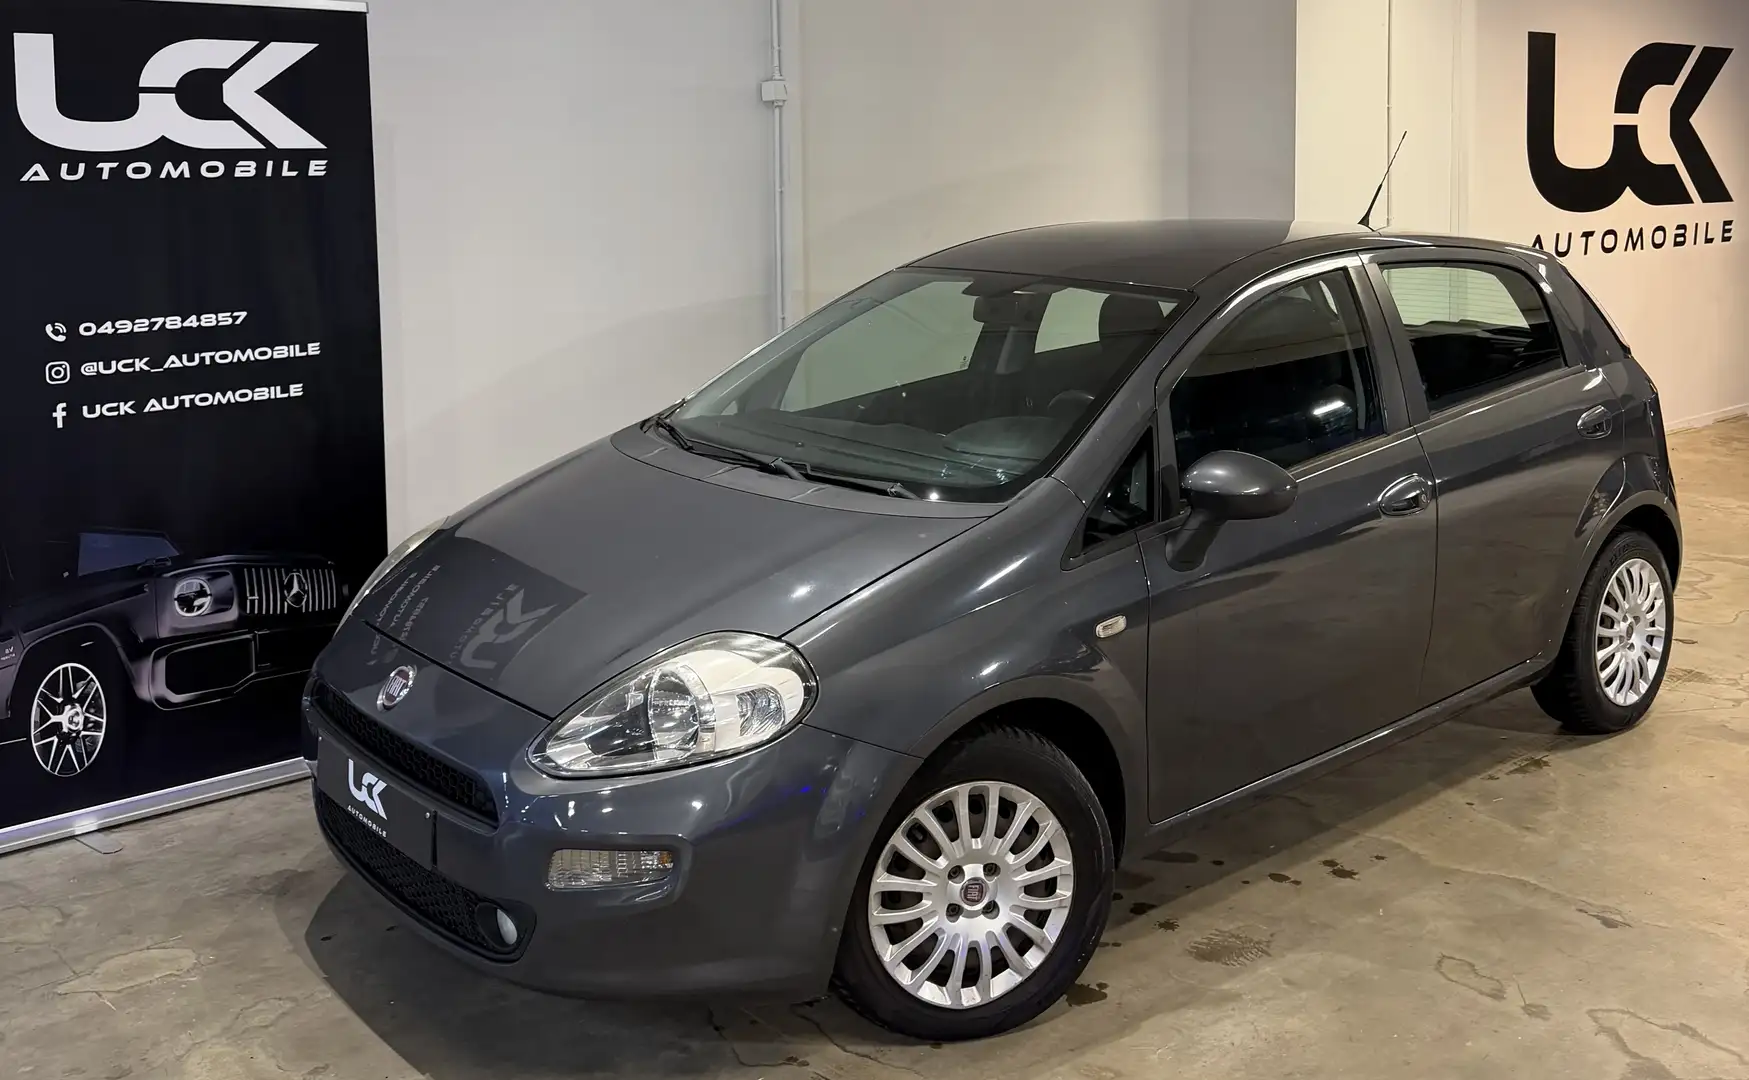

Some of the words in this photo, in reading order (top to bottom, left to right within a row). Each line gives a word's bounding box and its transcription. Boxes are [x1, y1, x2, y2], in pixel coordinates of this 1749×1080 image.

[13, 32, 328, 152] UCK
[1526, 31, 1735, 213] UCK
[20, 160, 328, 182] AUTOMOBILE
[78, 311, 248, 337] 0492784857
[80, 341, 321, 377] @UCK_AUTOMOBILE
[82, 400, 137, 419] UCK
[143, 383, 304, 413] AUTOMOBILE
[386, 674, 407, 697] FIAT
[348, 758, 388, 821] UCK
[347, 804, 387, 838] AUTOMOBILE
[966, 883, 980, 901] FIAT
